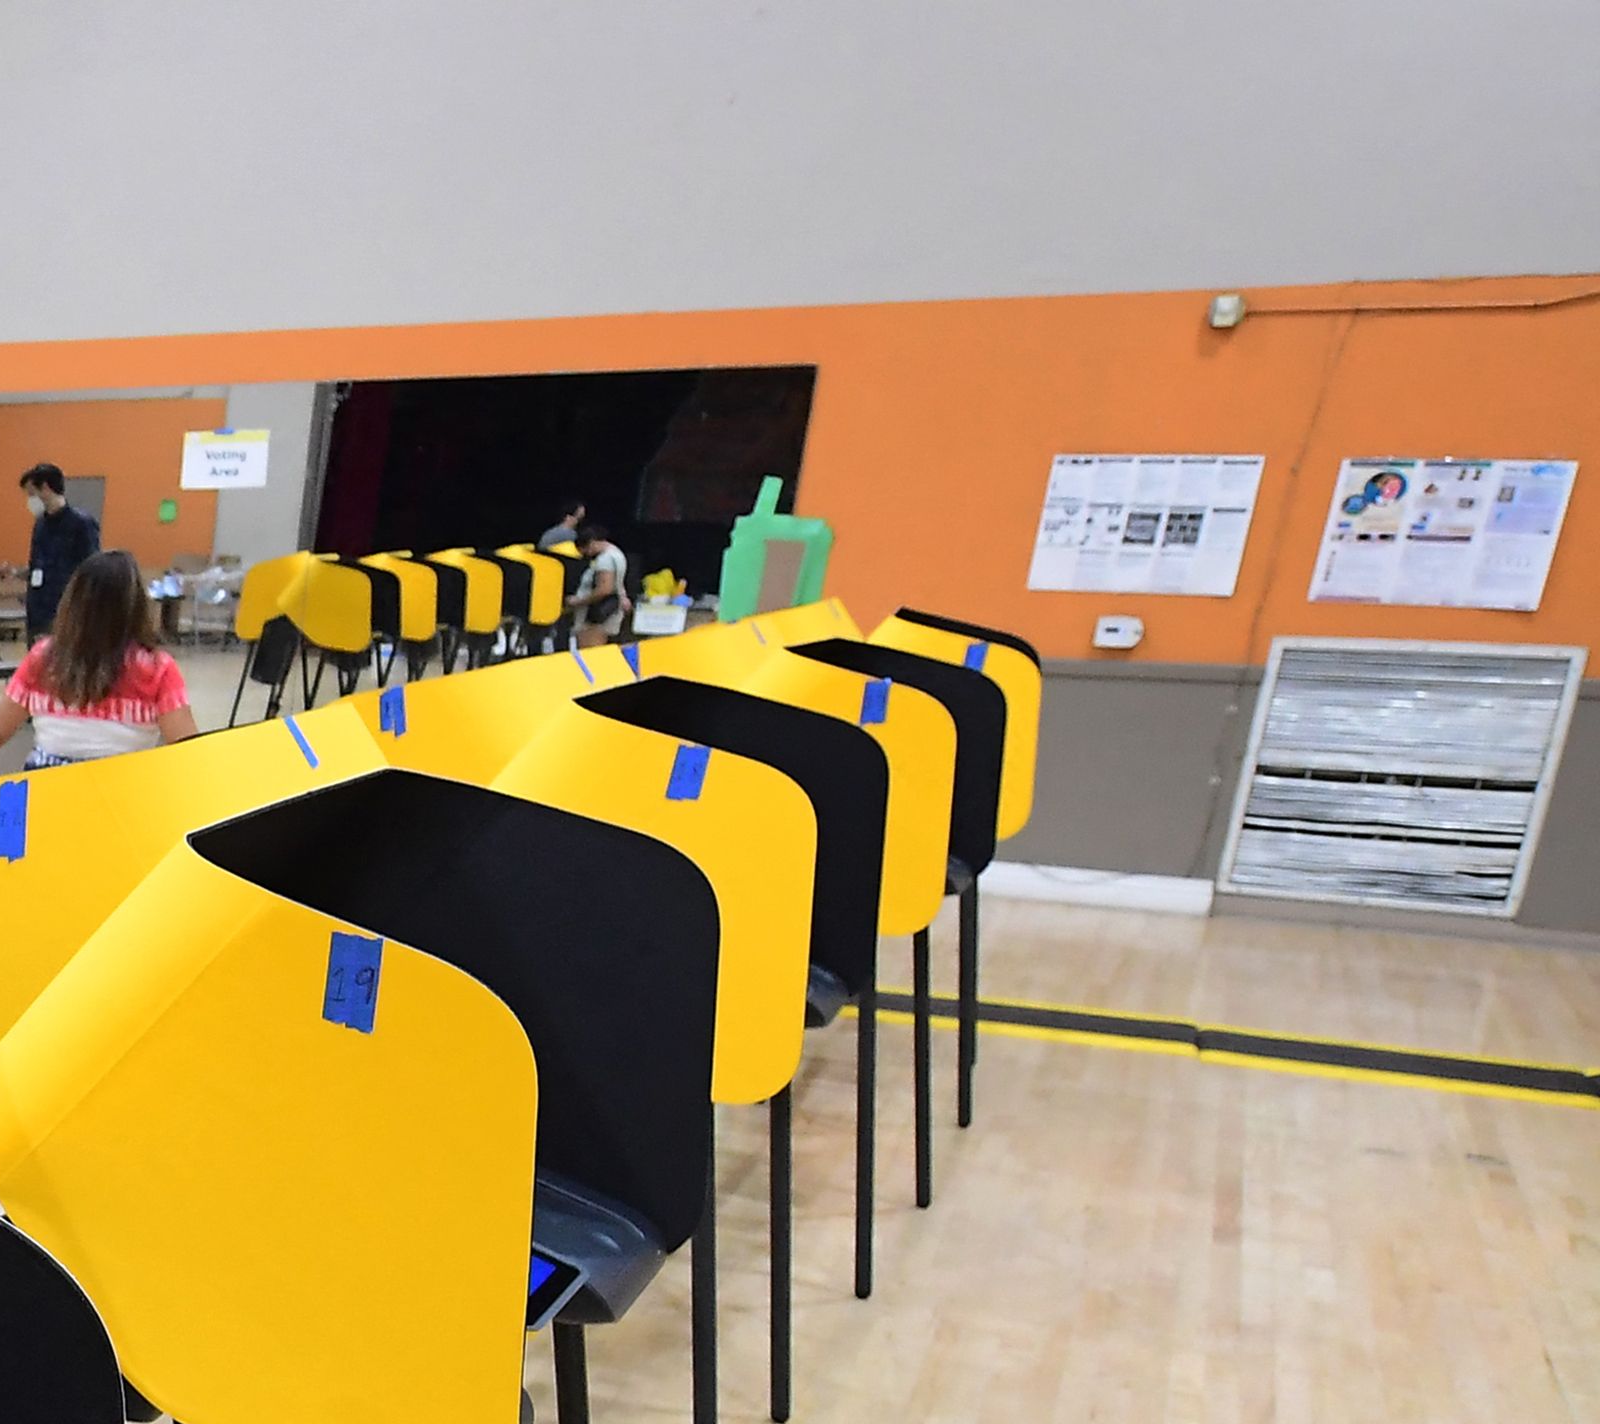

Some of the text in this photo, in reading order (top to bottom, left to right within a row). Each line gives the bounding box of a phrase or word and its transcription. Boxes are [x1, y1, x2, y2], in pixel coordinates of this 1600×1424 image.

[204, 449, 248, 462] Voting
[209, 466, 240, 477] Area
[332, 966, 375, 1005] 19
